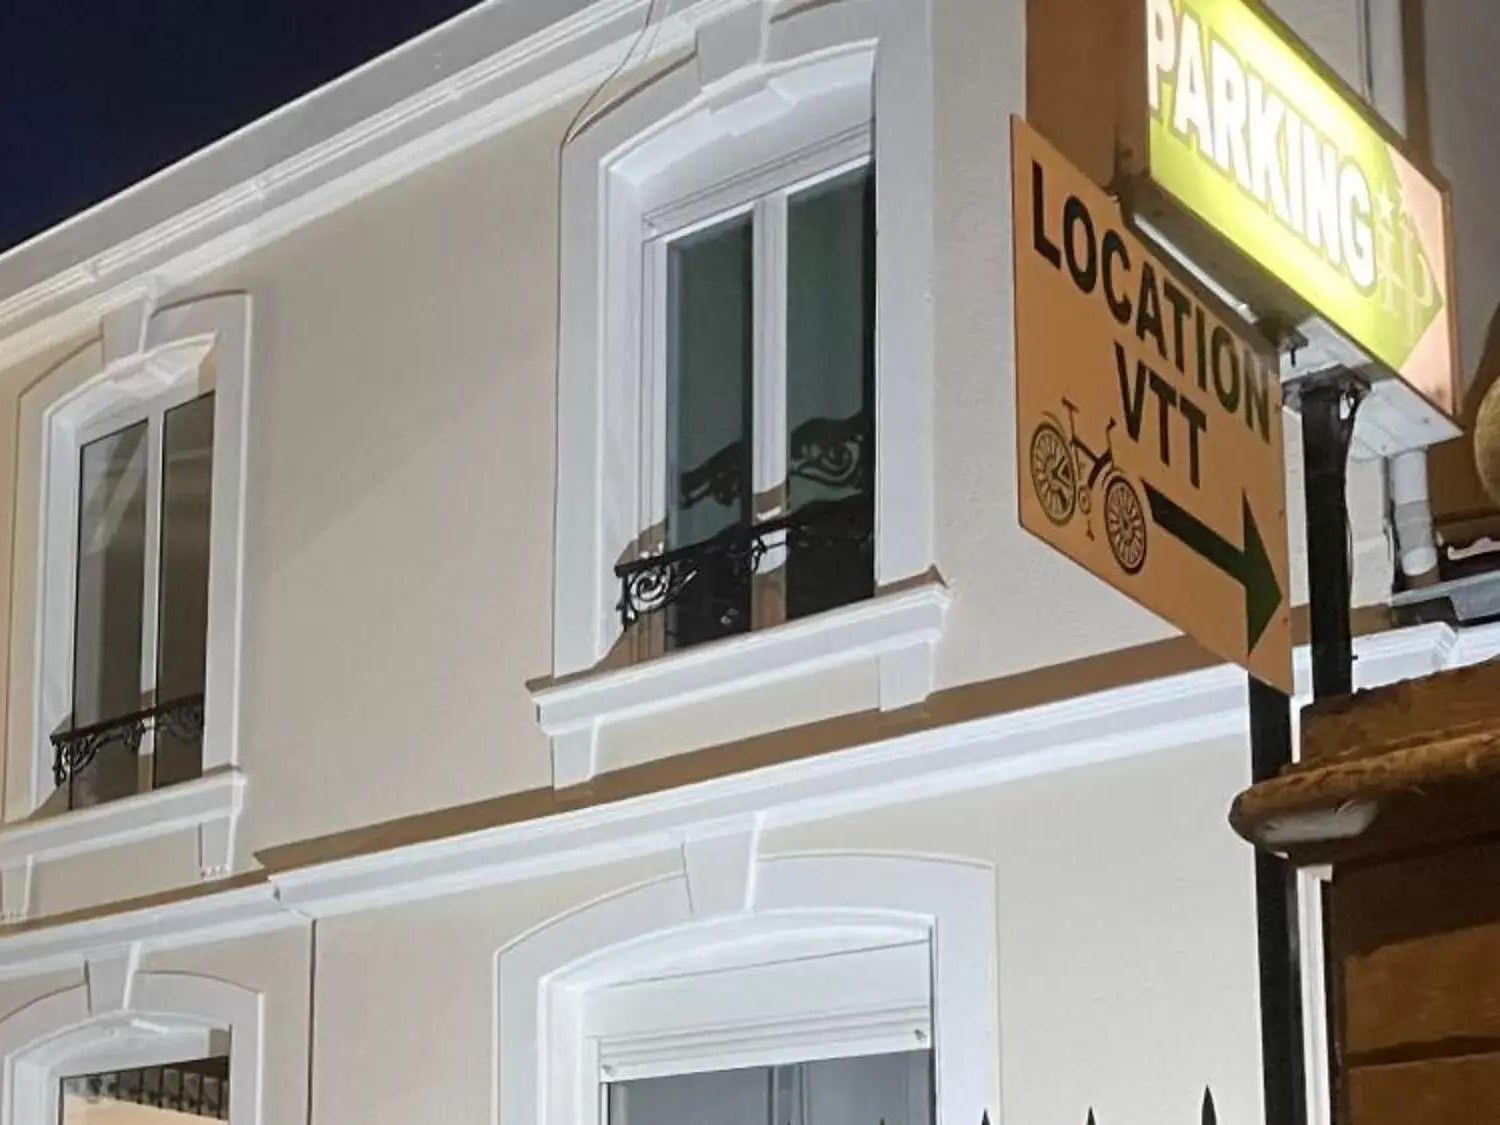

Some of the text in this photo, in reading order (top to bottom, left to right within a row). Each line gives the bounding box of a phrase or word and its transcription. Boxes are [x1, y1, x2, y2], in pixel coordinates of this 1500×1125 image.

[1146, 0, 1378, 294] PARKING
[1031, 158, 1271, 445] LOCATION
[1113, 339, 1208, 490] VTT
